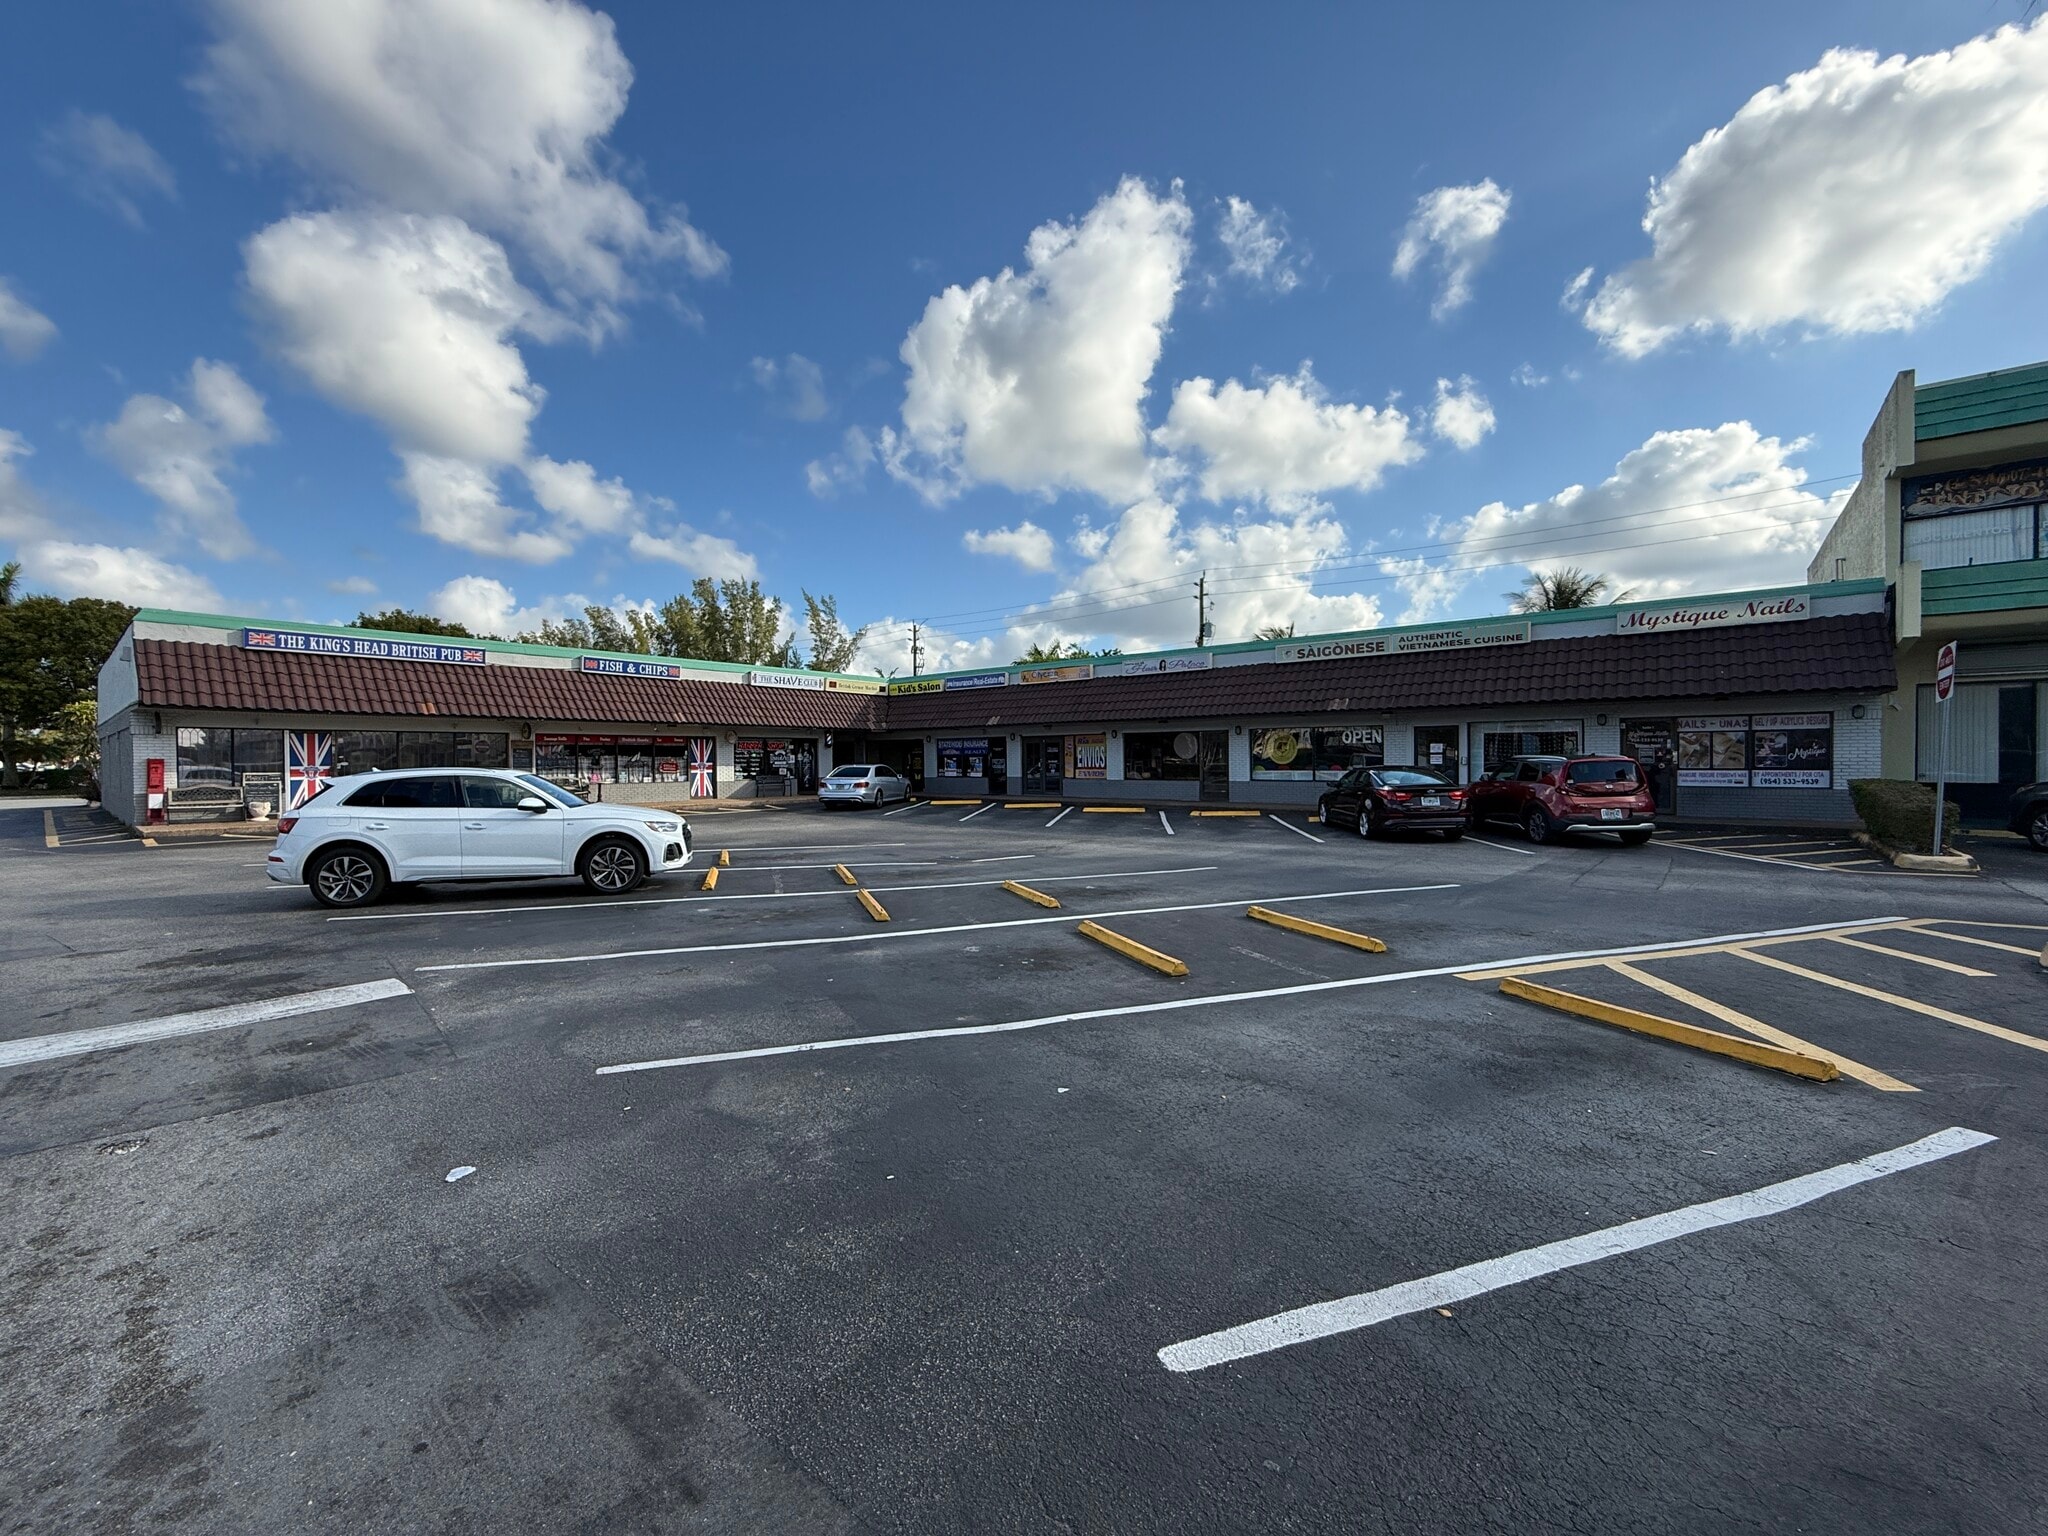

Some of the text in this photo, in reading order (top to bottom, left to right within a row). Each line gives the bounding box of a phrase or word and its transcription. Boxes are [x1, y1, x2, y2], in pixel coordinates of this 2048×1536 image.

[1913, 527, 2012, 544] DOCUMENTOS
[1621, 598, 1805, 631] Mystique Nails
[1398, 630, 1463, 643] AUTHENTIC
[1398, 633, 1524, 651] VIETNAMESE CUISINE
[278, 634, 461, 661] THE KING'S HEAD BRITISH PUB
[599, 660, 668, 676] FISH & CHIPS
[760, 675, 819, 688] THE SHAVE CLUB
[897, 685, 917, 694] Kid's
[917, 683, 941, 692] Salon
[1677, 719, 1707, 729] NAILS
[1342, 729, 1383, 744] OPEN
[1077, 746, 1105, 768] ENVIOS
